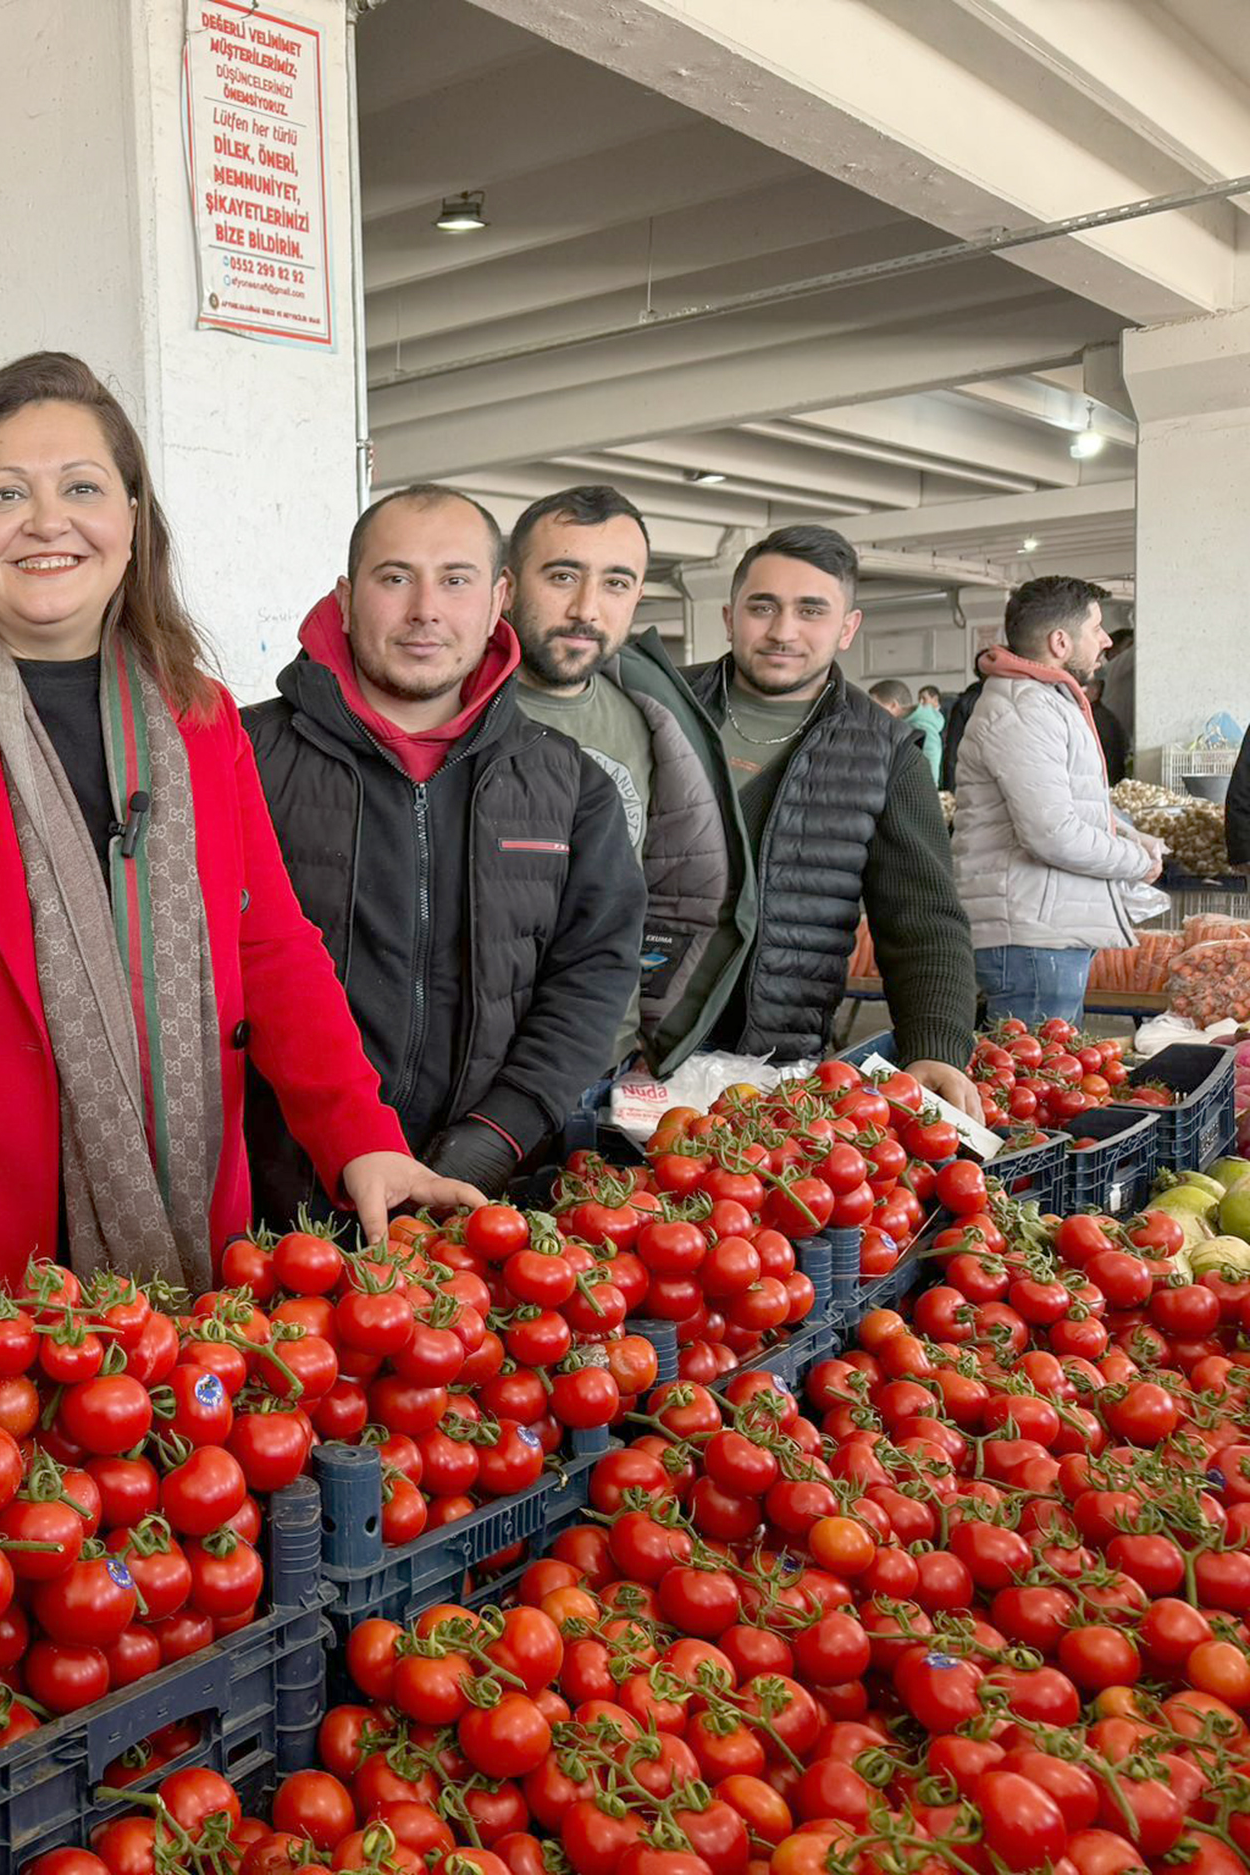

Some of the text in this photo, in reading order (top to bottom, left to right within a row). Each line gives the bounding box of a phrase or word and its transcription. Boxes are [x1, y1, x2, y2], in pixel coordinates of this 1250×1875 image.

[201, 12, 246, 39] DEĞERLİ
[216, 64, 293, 99] DÜŞÜNCELERİNİZİ
[213, 107, 297, 146] Lütfen her türlü
[213, 133, 298, 176] DİLEK, ÖNERİ,
[213, 164, 300, 205] MEMNUNİYET,
[205, 189, 310, 233] ŞİKAYETLERİNİZİ
[215, 220, 303, 260] BİZE BİLDİRİN.
